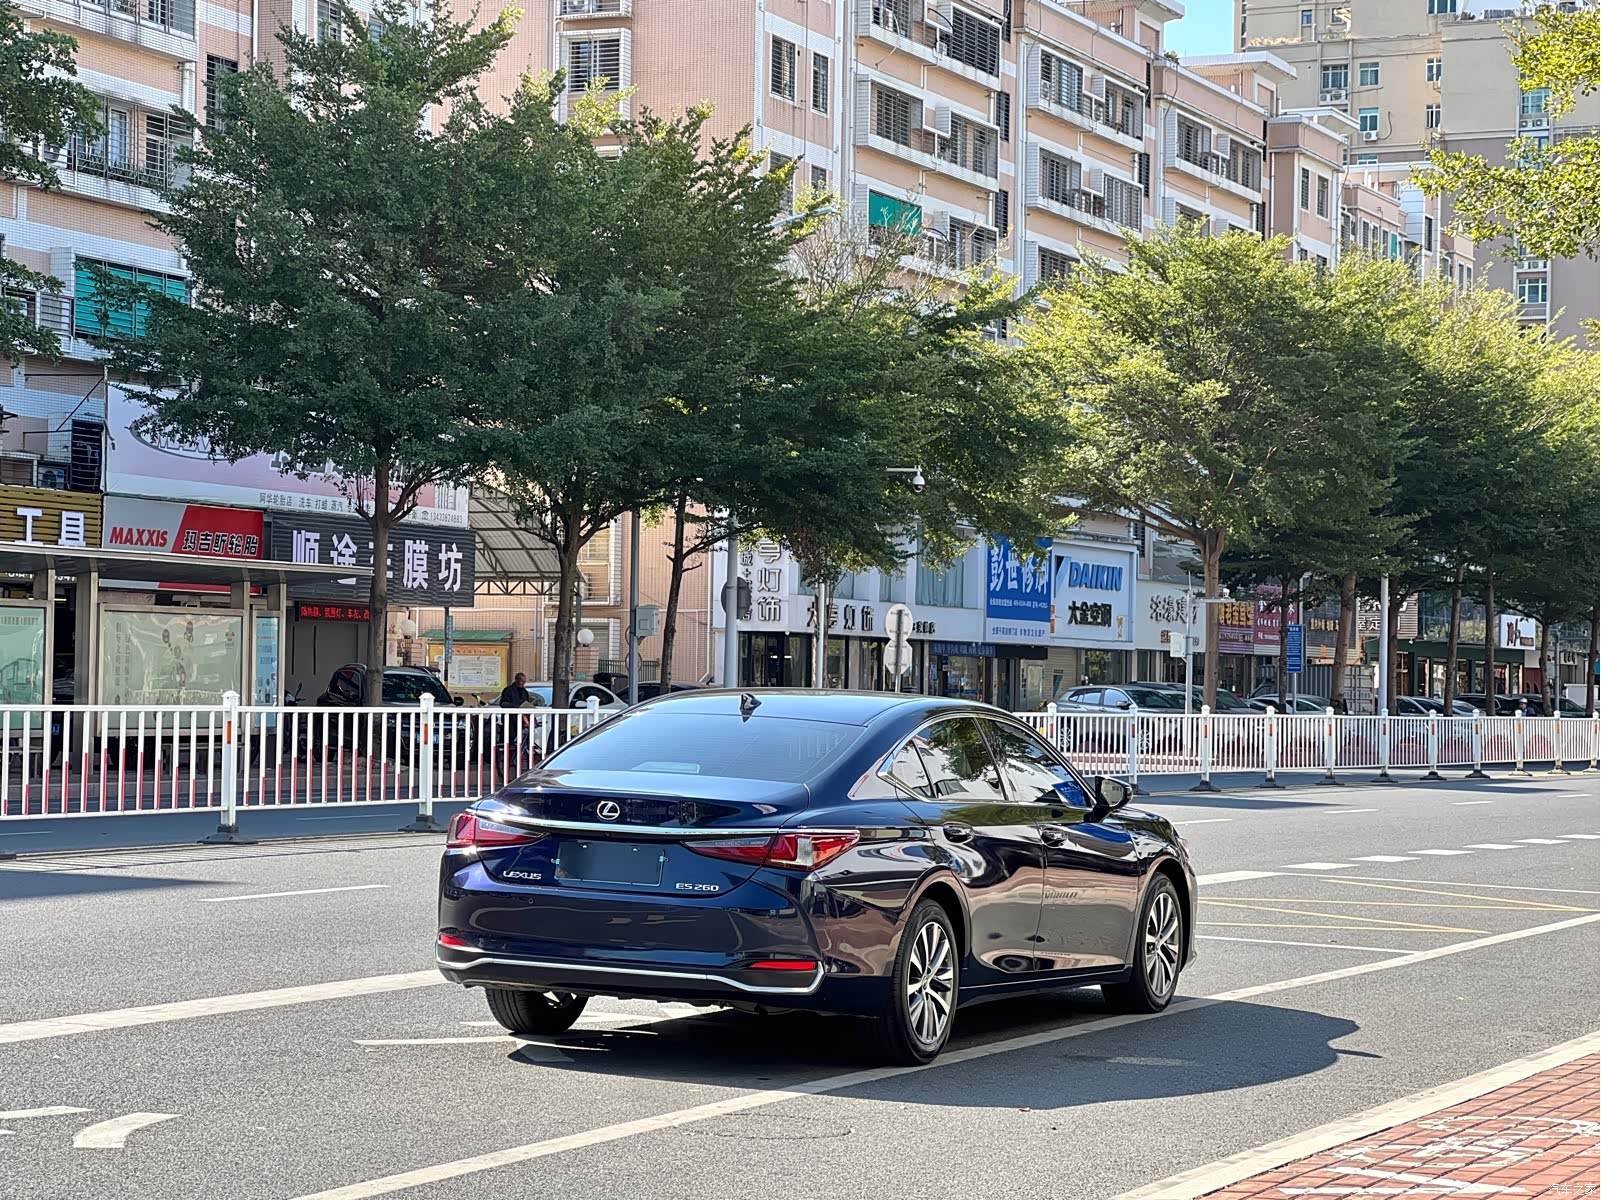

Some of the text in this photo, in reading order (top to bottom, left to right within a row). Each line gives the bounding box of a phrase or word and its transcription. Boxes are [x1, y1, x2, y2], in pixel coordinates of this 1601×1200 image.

[299, 497, 312, 509] 洗车
[15, 507, 87, 547] 工具
[109, 526, 168, 548] MAXXIS
[182, 530, 259, 556] 玛吉斯轮胎
[1068, 562, 1123, 592] DAIKIN
[1067, 600, 1113, 628] 大金空调
[503, 871, 542, 880] LEXUS
[675, 882, 720, 892] ES 260
